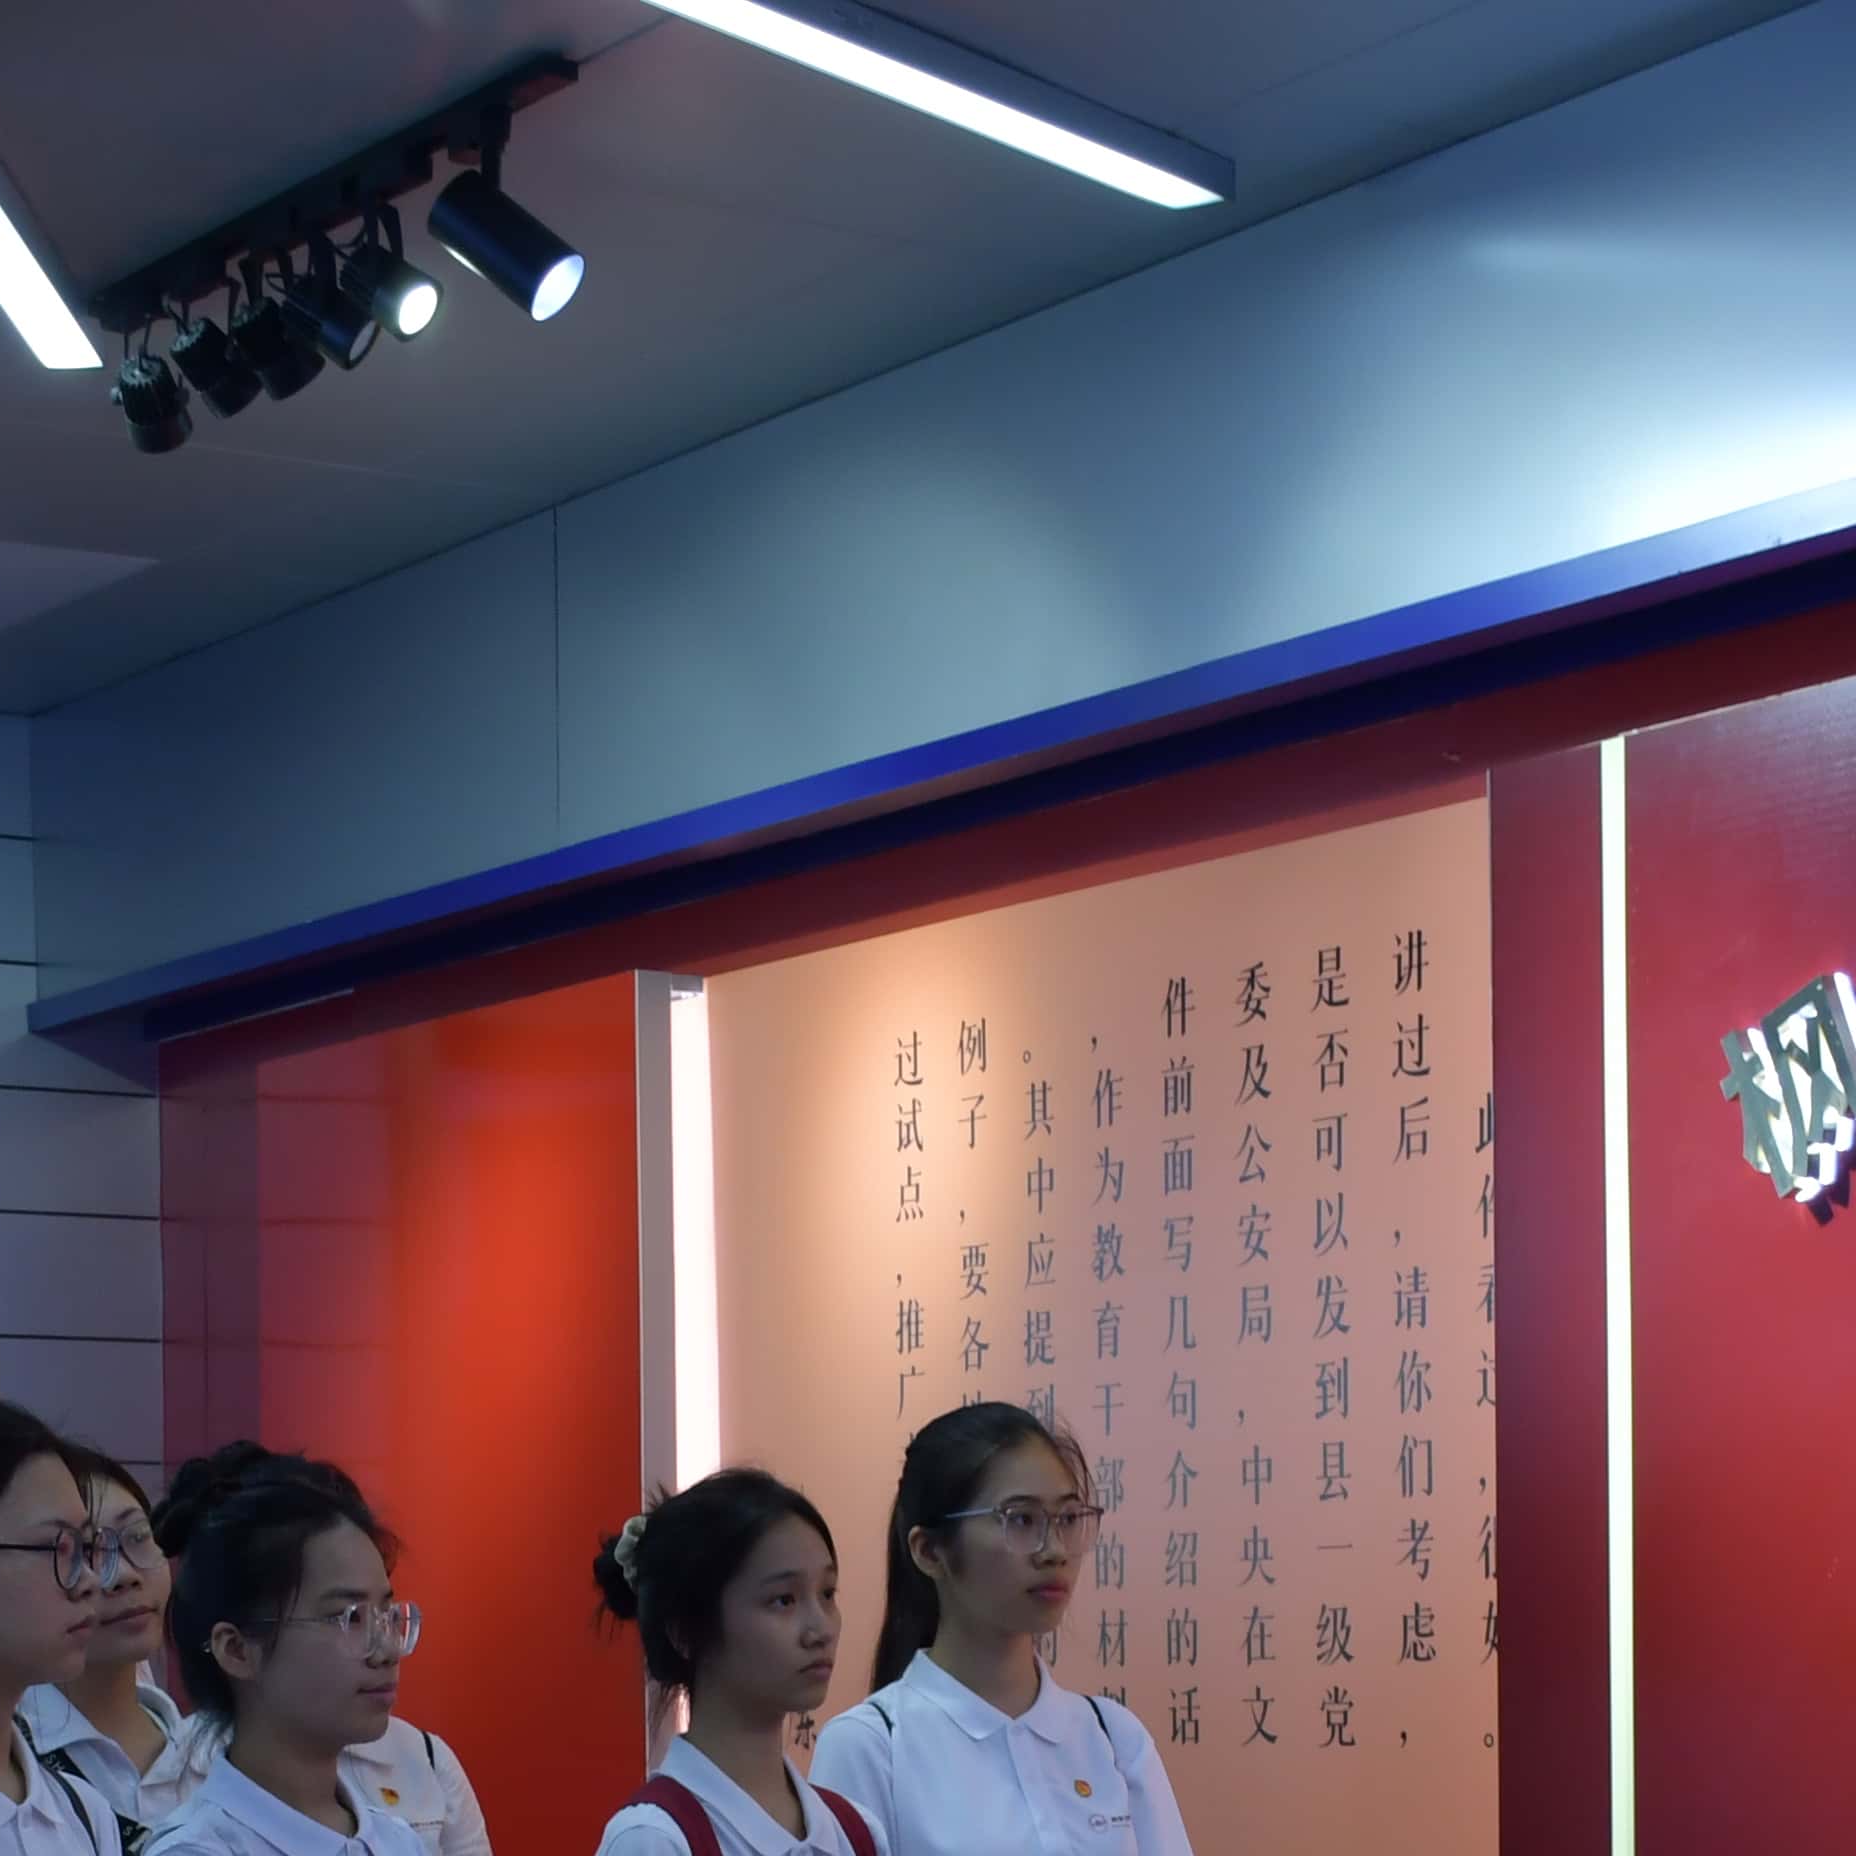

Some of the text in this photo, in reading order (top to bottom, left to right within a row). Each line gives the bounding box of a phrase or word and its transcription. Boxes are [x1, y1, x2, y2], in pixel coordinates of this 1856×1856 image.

[1159, 975, 1202, 1746] 件前面写几句介绍的话
[1310, 945, 1357, 1749] 是否可以发到县一级党
